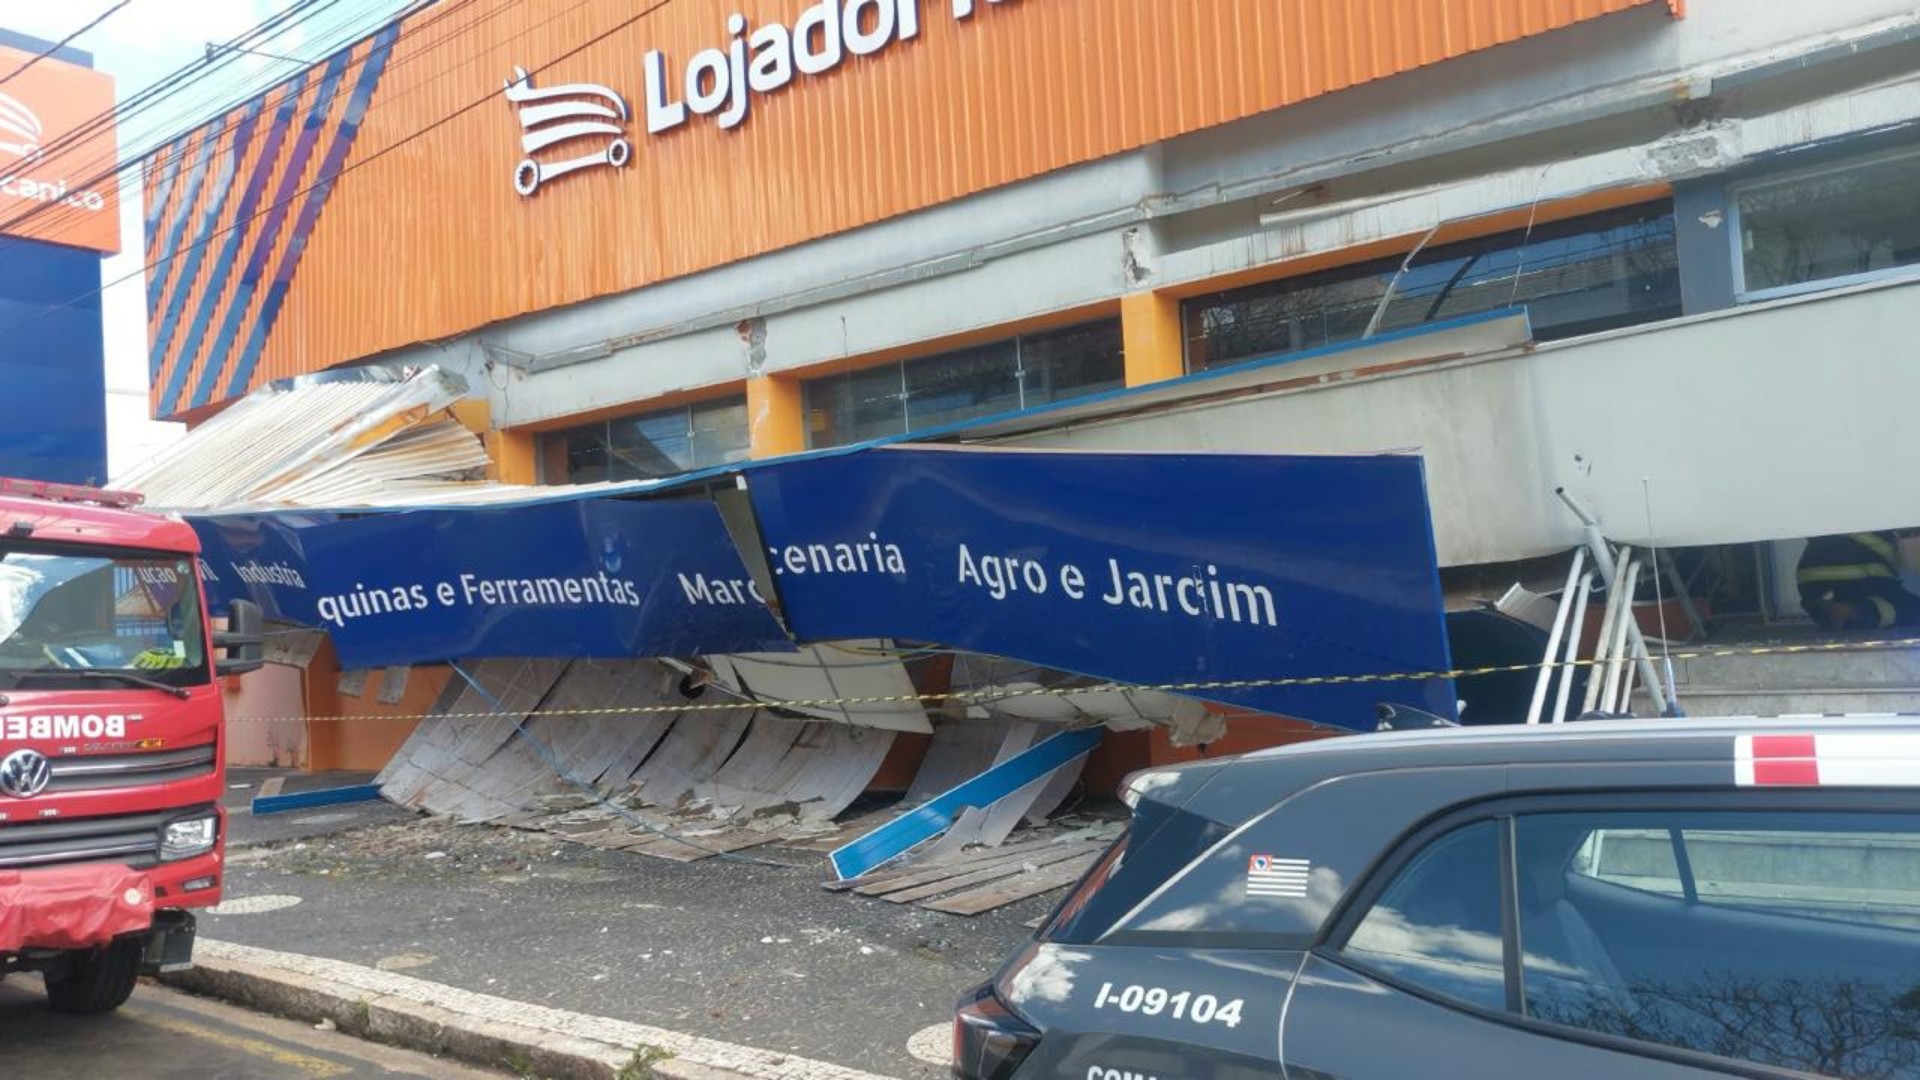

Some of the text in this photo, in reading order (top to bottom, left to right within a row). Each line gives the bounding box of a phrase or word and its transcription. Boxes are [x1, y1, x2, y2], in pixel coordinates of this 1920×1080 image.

[644, 0, 1000, 133] Lojado
[317, 583, 429, 627] quinas
[436, 582, 456, 606] e
[459, 570, 640, 606] Ferramentas
[958, 543, 1048, 600] Agro
[1059, 564, 1086, 600] e
[1094, 982, 1244, 1028] I-09104
